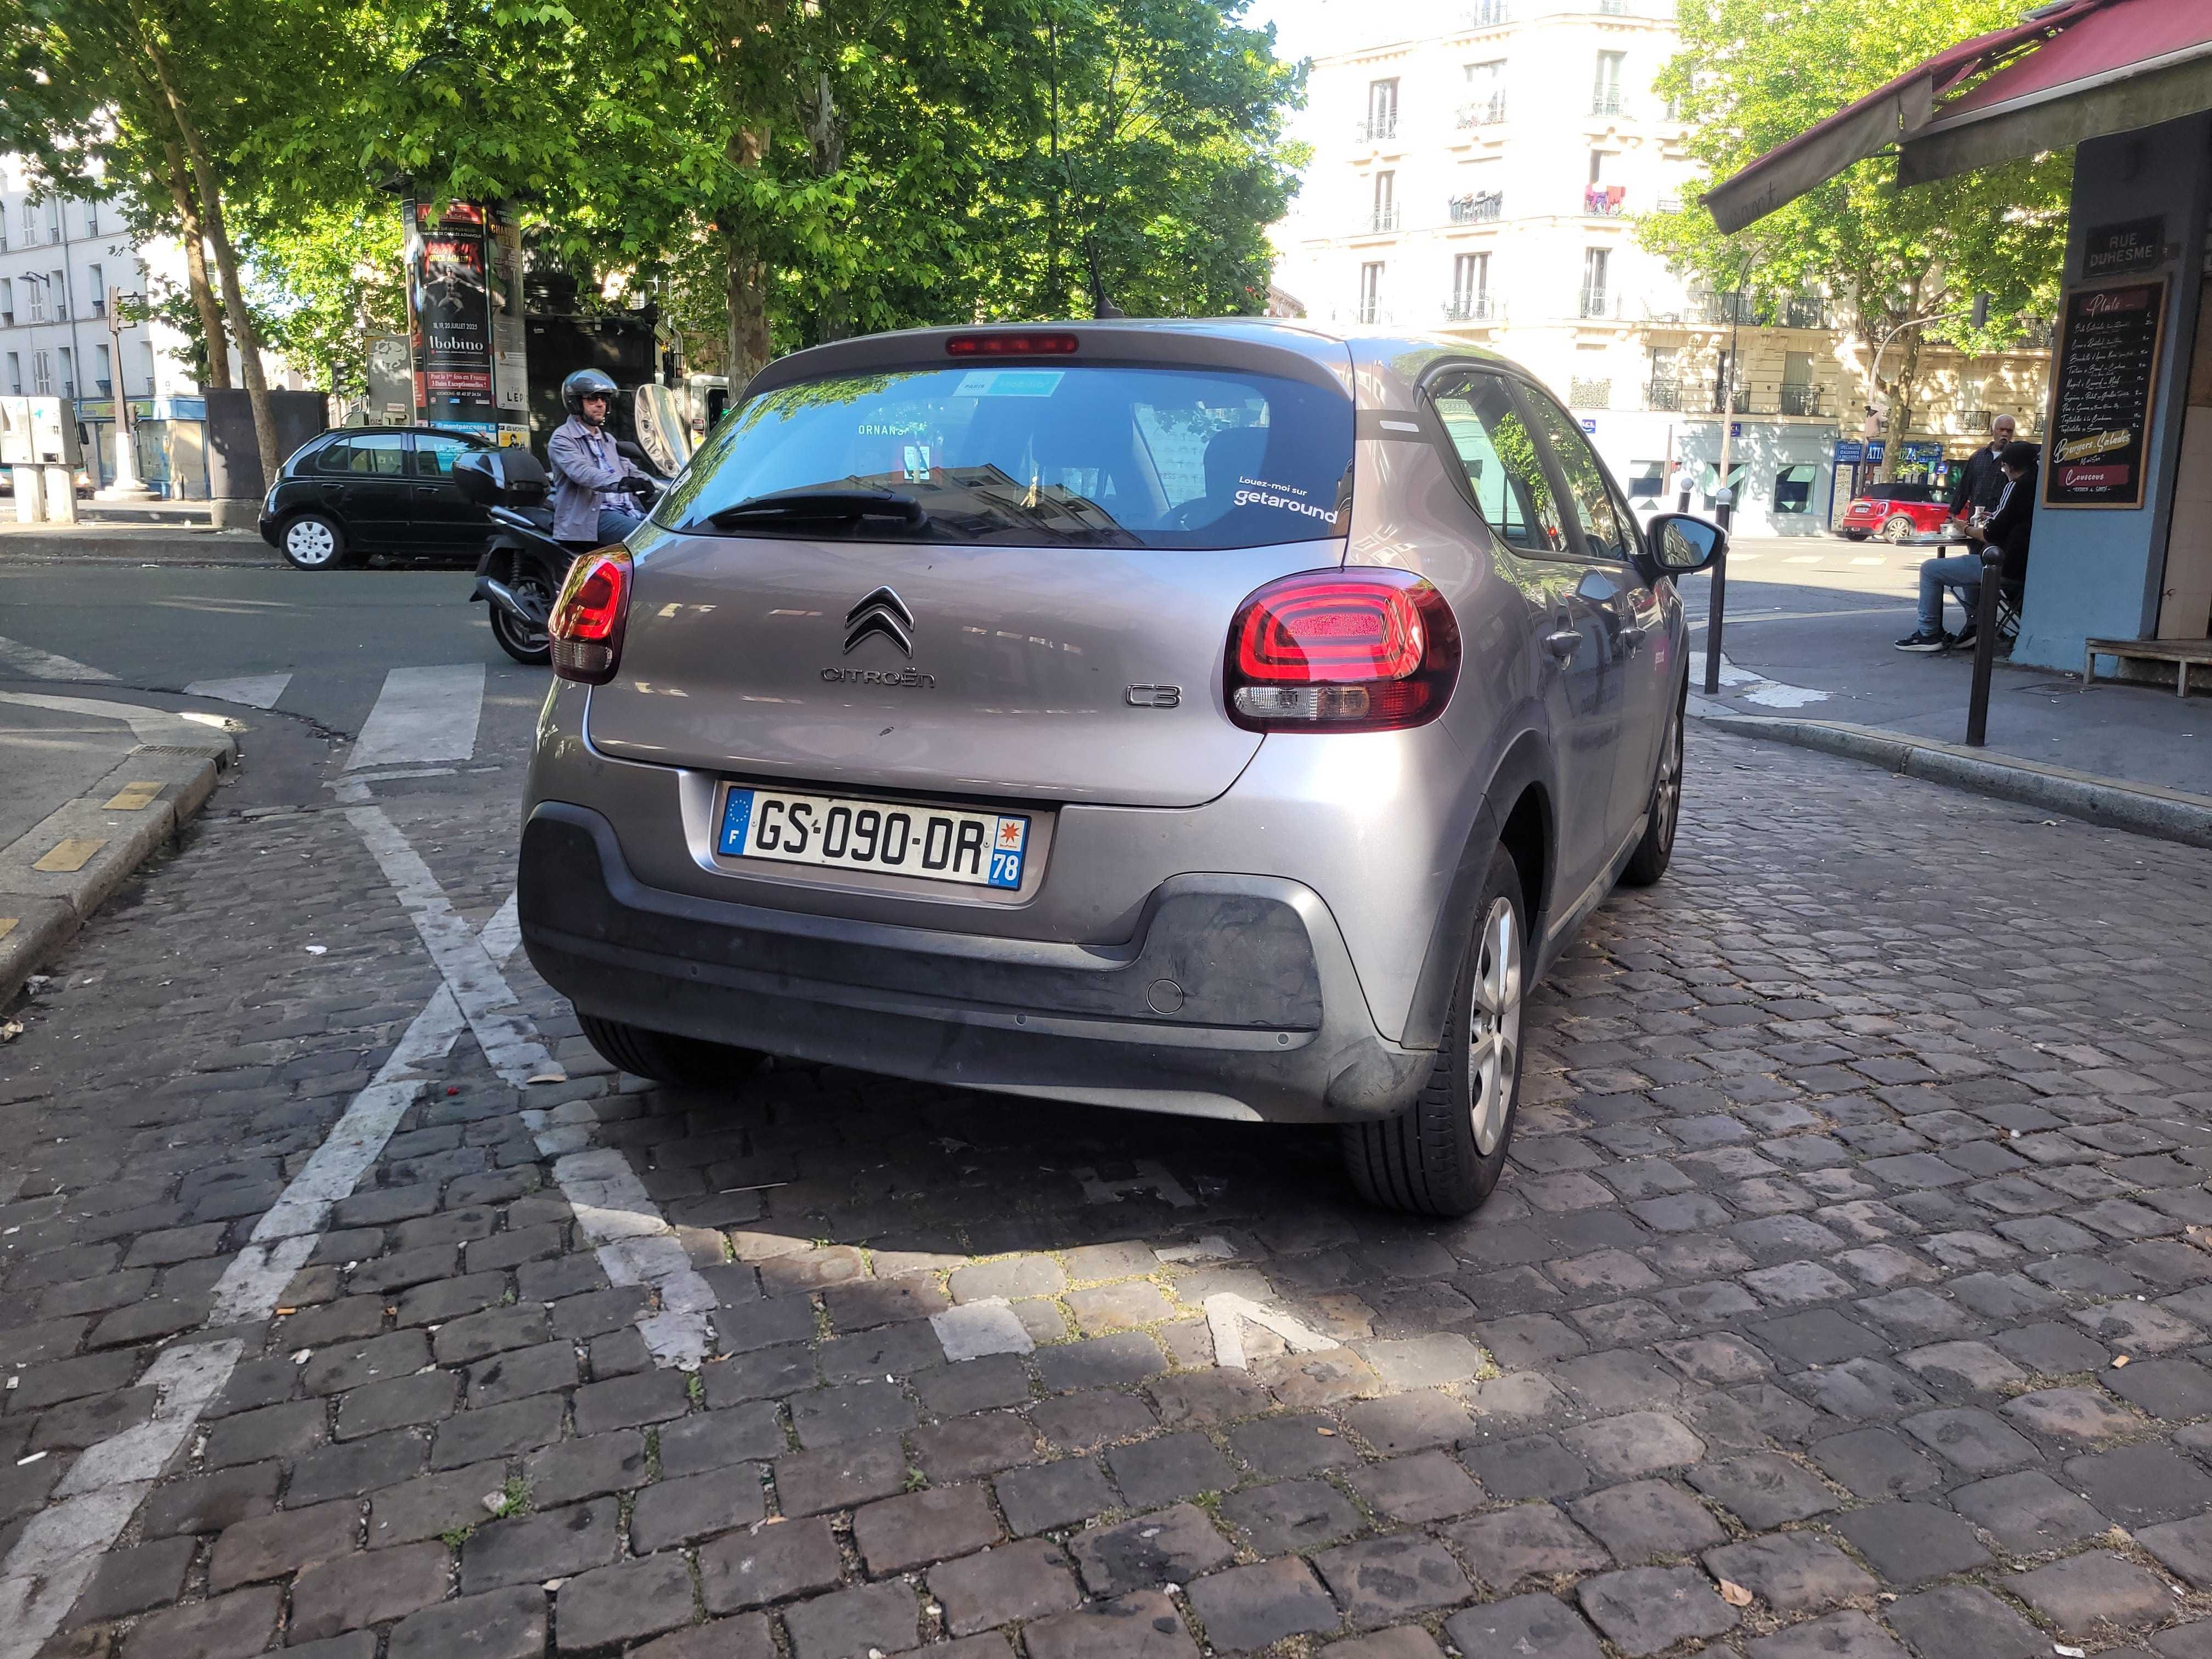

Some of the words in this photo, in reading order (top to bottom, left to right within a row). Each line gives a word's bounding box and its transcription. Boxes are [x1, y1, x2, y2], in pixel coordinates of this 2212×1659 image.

[2109, 233, 2138, 249] RUE
[2089, 245, 2154, 268] DUHESME
[2053, 437, 2094, 464] Burgers
[2096, 430, 2132, 453] Salades
[1239, 475, 1291, 493] Louez-moi
[1291, 487, 1307, 496] sur
[2066, 469, 2104, 486] Couscous
[1233, 490, 1339, 524] getaround
[821, 667, 935, 688] CITROËN
[1125, 683, 1183, 708] C3
[728, 831, 740, 845] F
[992, 853, 1019, 881] 78
